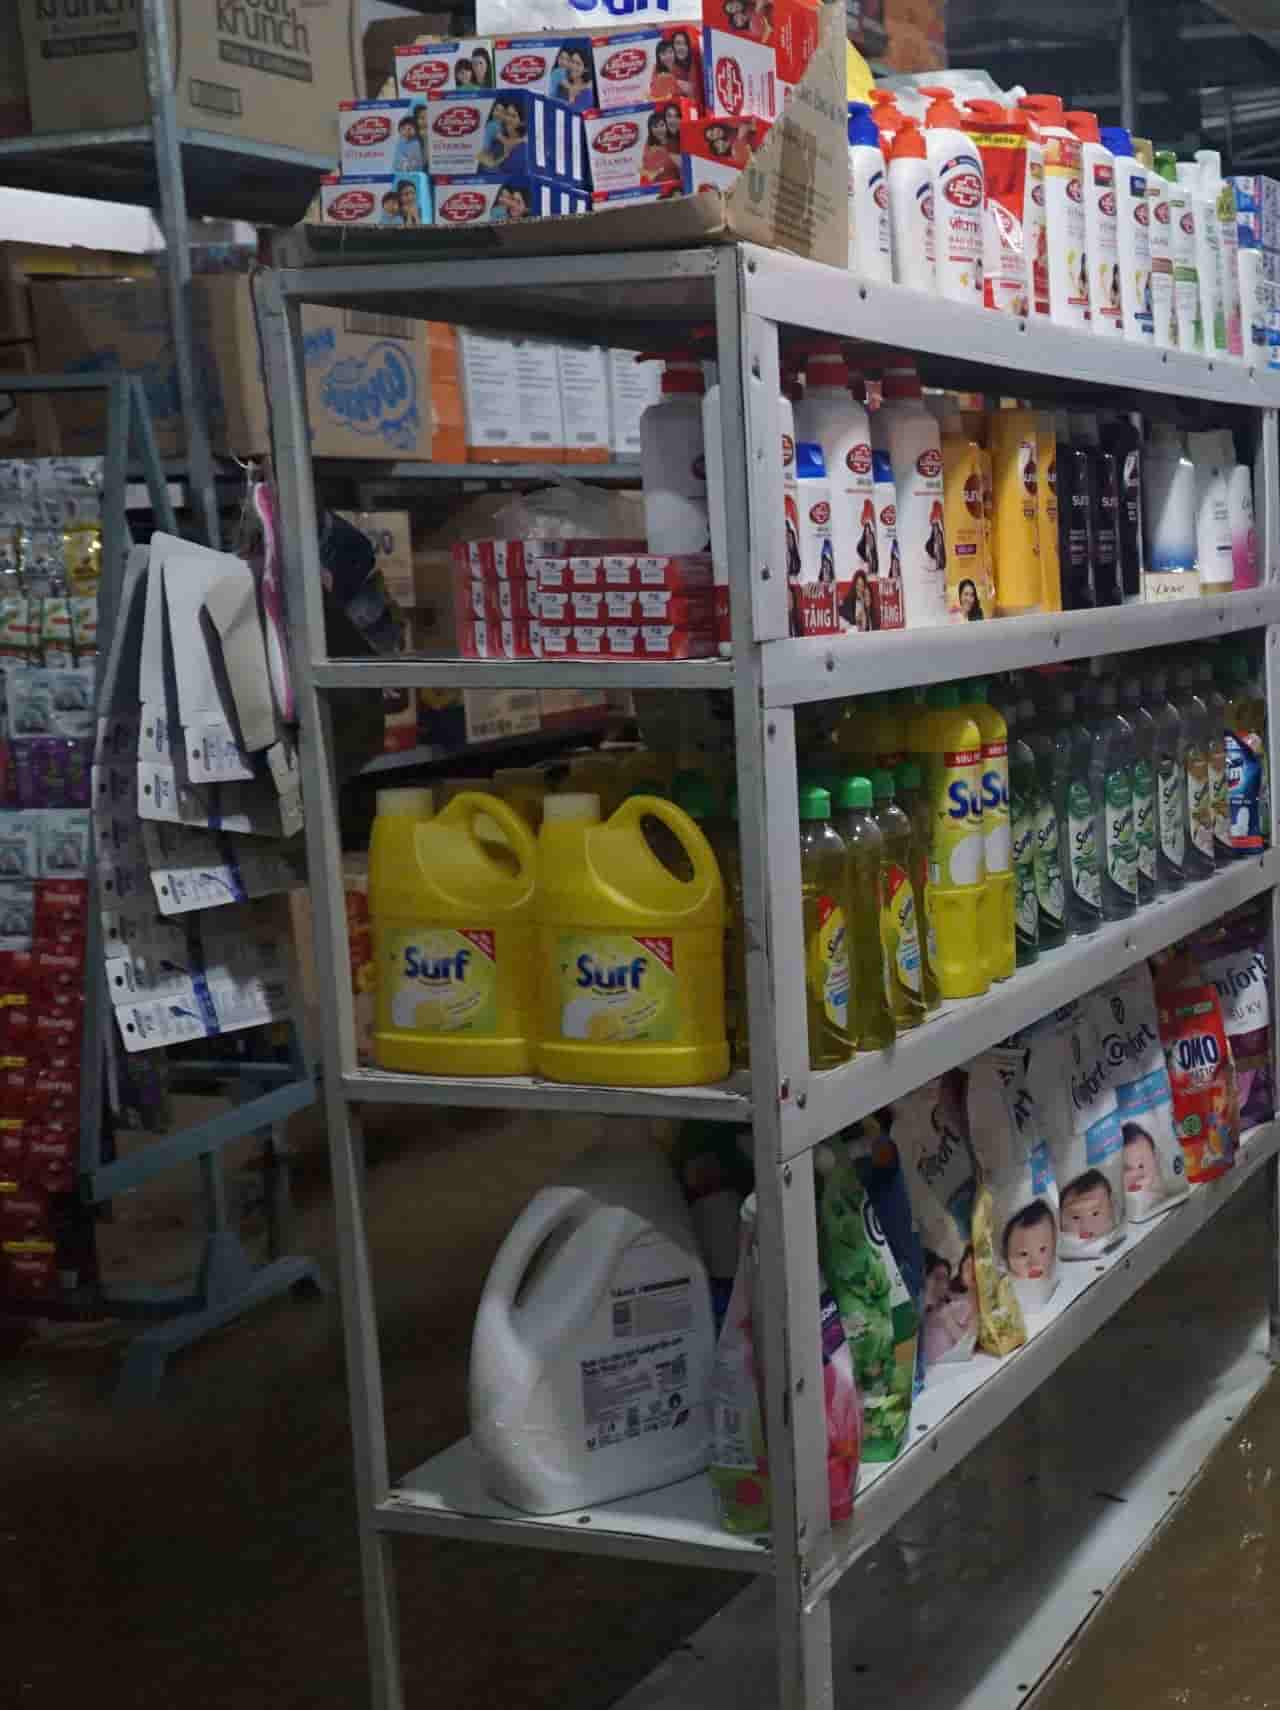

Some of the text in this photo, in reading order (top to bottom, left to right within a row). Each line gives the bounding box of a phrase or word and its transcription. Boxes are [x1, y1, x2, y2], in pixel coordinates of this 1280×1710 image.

[404, 945, 471, 982] Surf
[575, 952, 648, 991] Surf
[1178, 1035, 1219, 1071] OMO
